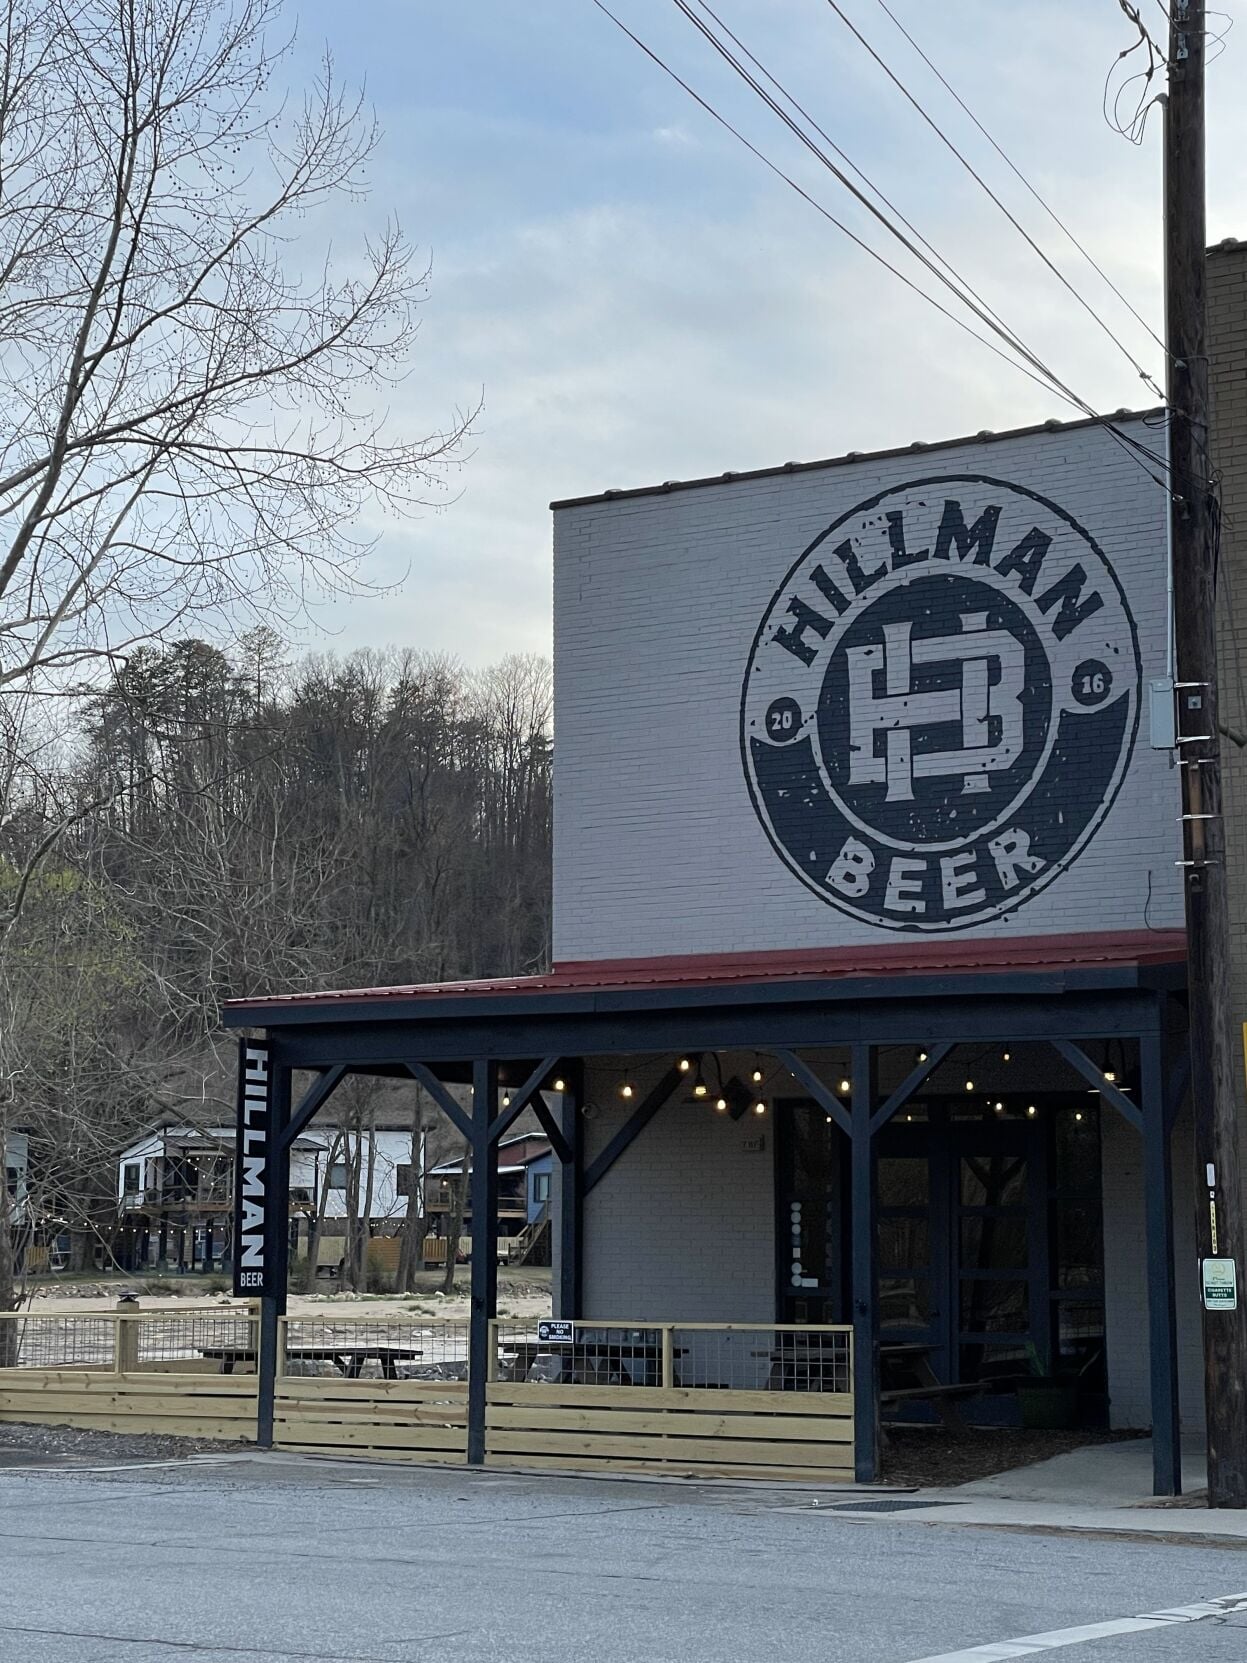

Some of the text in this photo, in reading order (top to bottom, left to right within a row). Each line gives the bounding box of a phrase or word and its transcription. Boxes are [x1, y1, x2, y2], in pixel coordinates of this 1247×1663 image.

[771, 499, 1104, 667] HILLMAN
[1081, 673, 1104, 694] 16
[771, 712, 792, 730] 20
[825, 827, 1048, 913] BEER
[241, 1048, 268, 1267] HILLMAN
[240, 1272, 263, 1287] BEER
